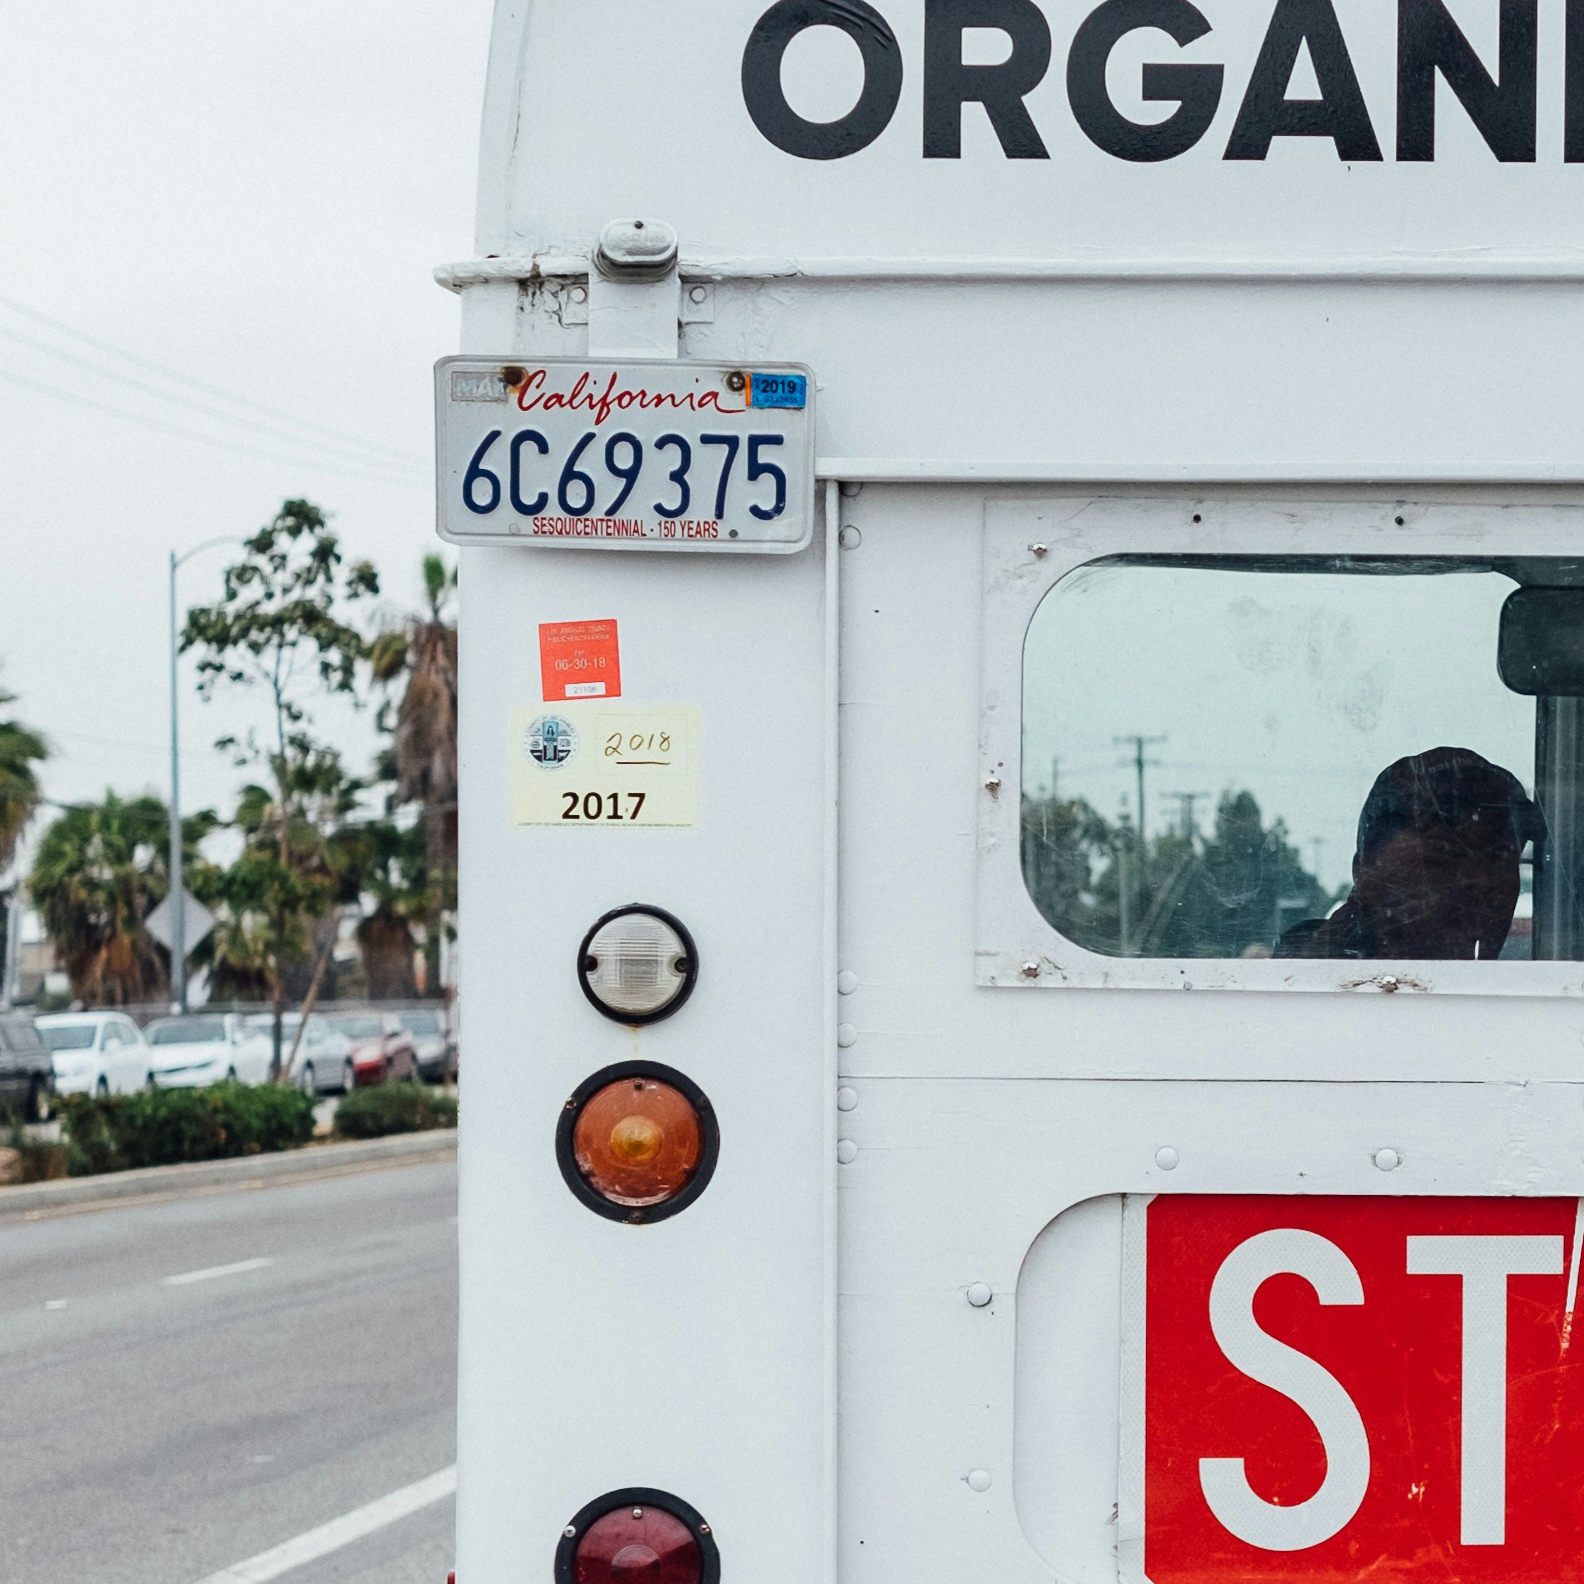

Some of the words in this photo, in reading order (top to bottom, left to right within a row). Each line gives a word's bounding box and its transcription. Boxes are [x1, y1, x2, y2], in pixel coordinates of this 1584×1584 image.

[516, 369, 746, 425] California
[761, 379, 796, 394] 2019
[462, 429, 786, 520] 6C69375
[532, 517, 647, 537] SESQUICENTENNIAL
[657, 520, 676, 537] 150
[679, 520, 719, 539] YEARS
[555, 657, 606, 671] 06-30-18
[604, 731, 672, 757] 2018
[561, 791, 646, 820] 2017
